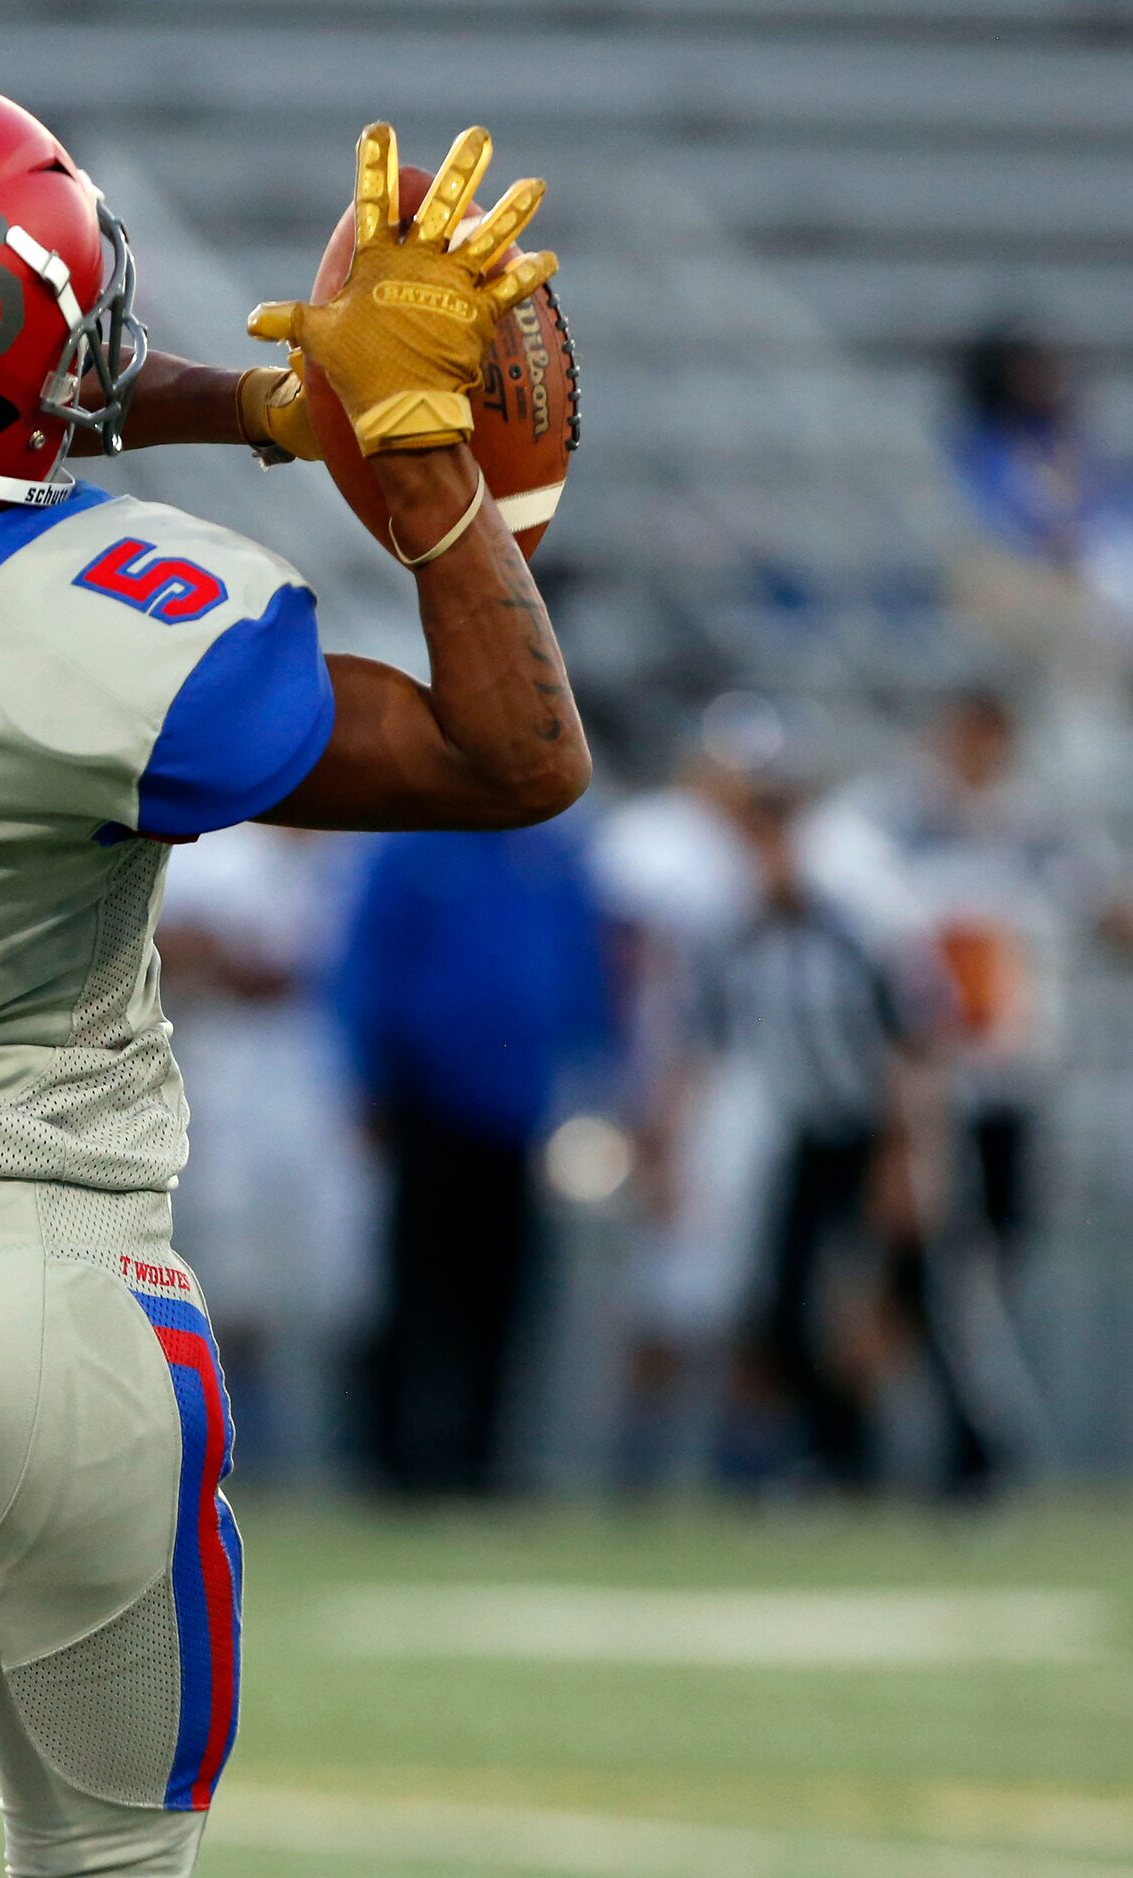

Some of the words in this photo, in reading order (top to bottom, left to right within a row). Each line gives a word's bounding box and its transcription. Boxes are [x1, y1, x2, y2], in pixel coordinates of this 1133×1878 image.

[383, 285, 470, 317] BATTLE
[71, 536, 229, 626] 5
[134, 1261, 191, 1292] WOLVES
